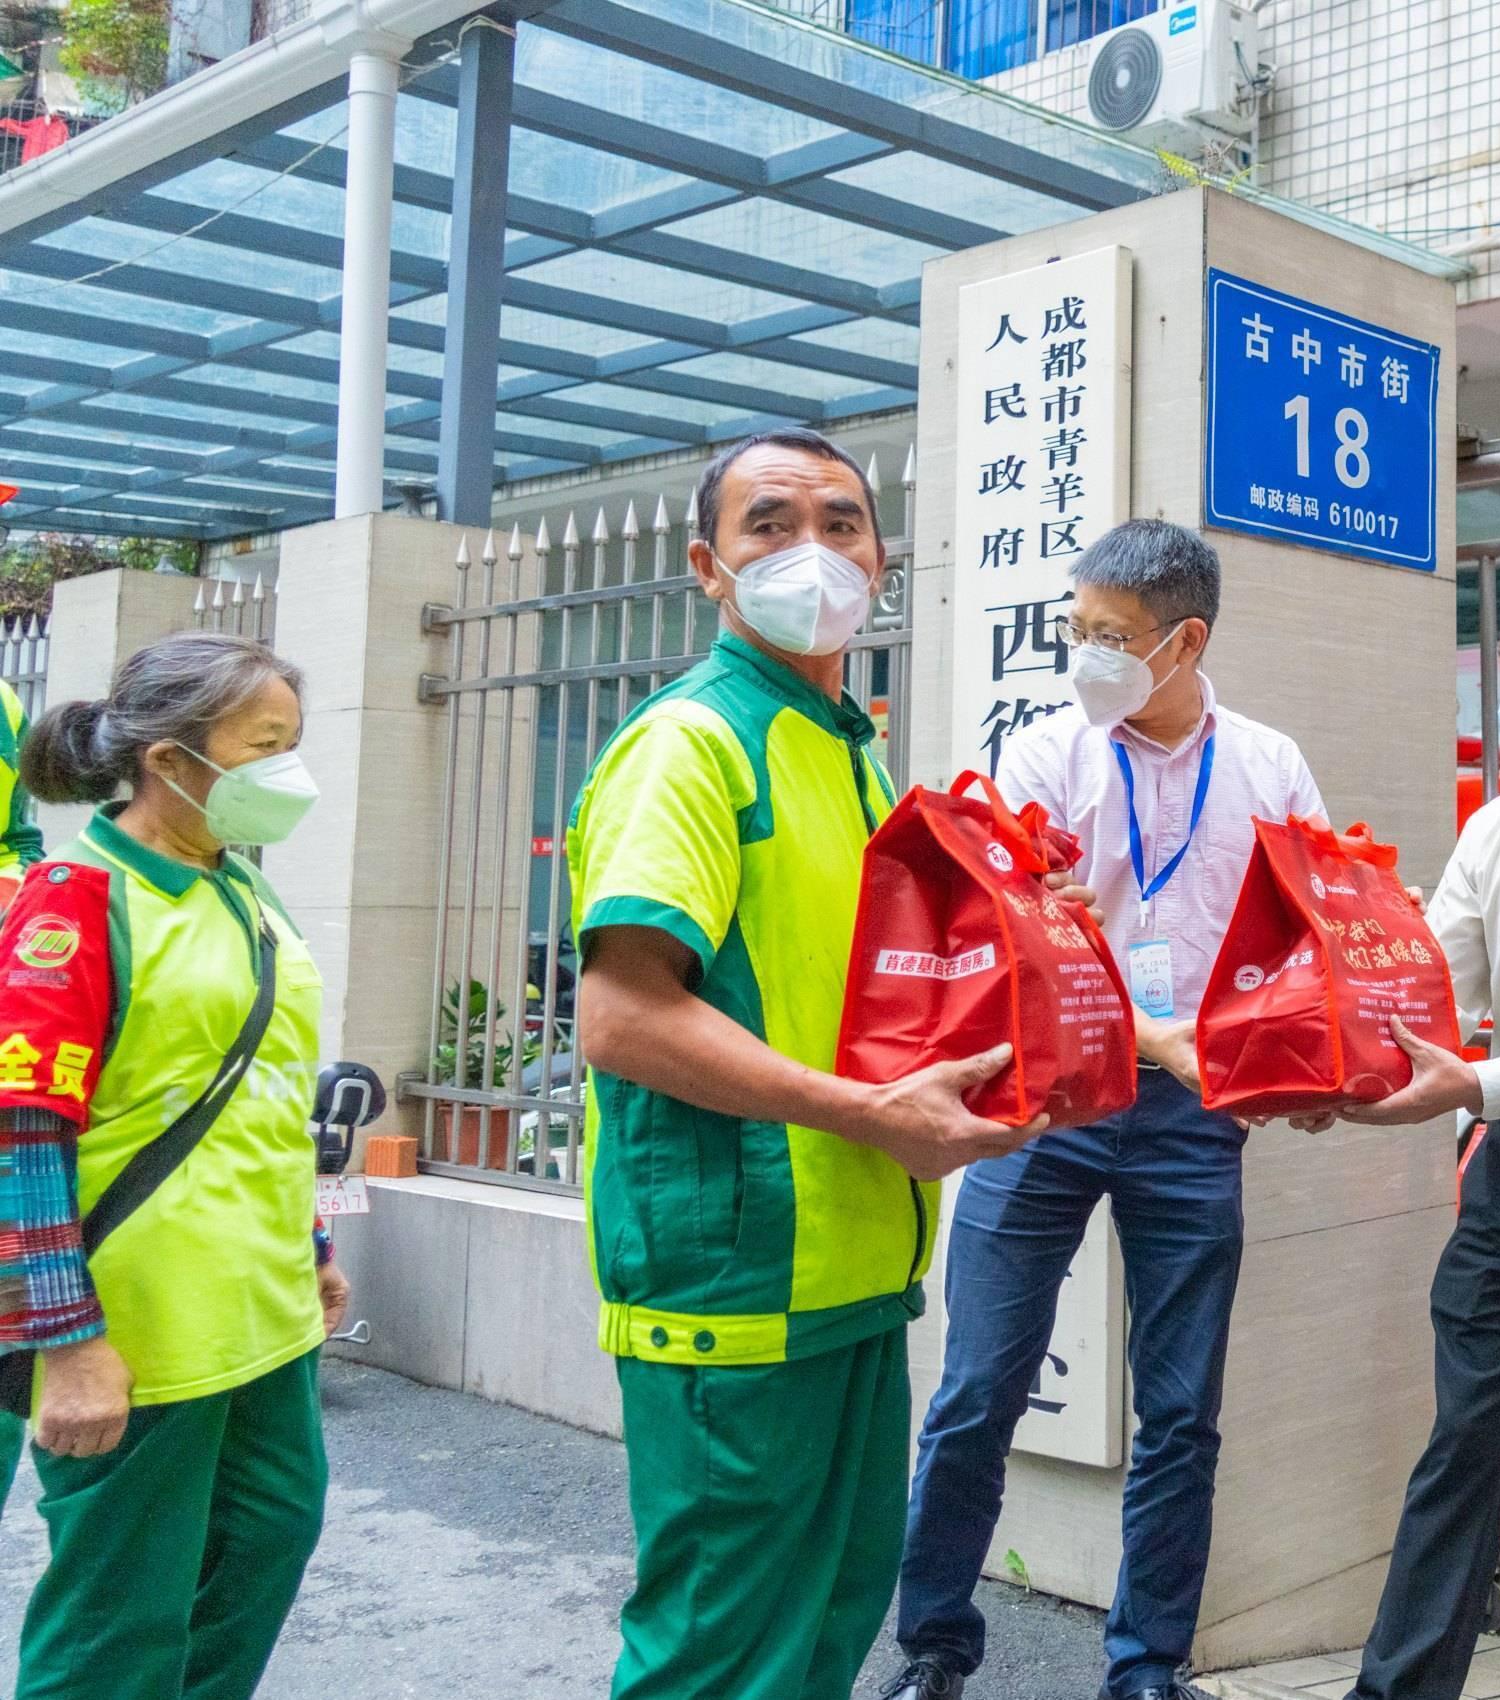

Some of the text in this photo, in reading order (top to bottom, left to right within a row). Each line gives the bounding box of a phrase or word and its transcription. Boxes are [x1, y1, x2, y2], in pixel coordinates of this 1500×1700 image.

[1242, 312, 1410, 404] 古中市街
[978, 313, 1028, 569] 人民政府
[1040, 296, 1087, 559] 成都市青羊区
[1284, 394, 1371, 489] 18
[1250, 483, 1399, 540] 邮政编码 610017
[0, 1032, 94, 1103] 全员
